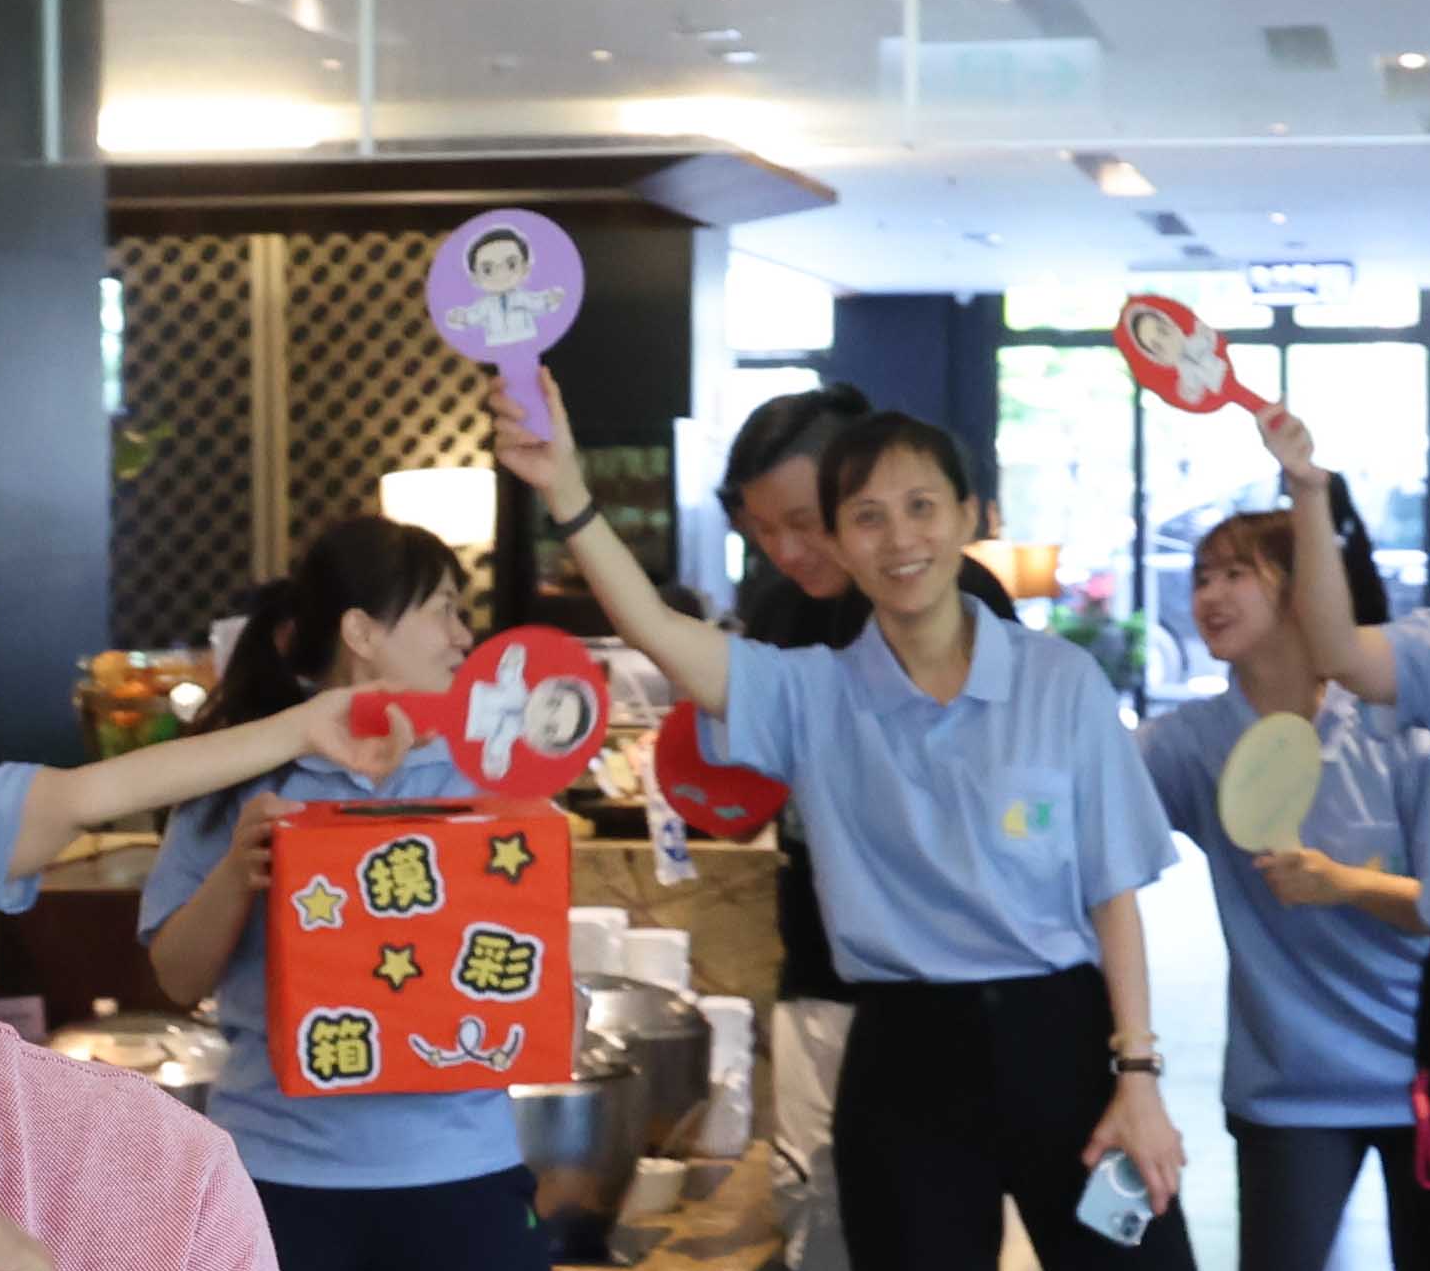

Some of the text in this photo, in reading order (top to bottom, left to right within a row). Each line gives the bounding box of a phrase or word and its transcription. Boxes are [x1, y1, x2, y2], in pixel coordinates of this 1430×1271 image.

[364, 838, 438, 912] 摸
[459, 929, 536, 994] 彩
[306, 1013, 374, 1083] 箱
